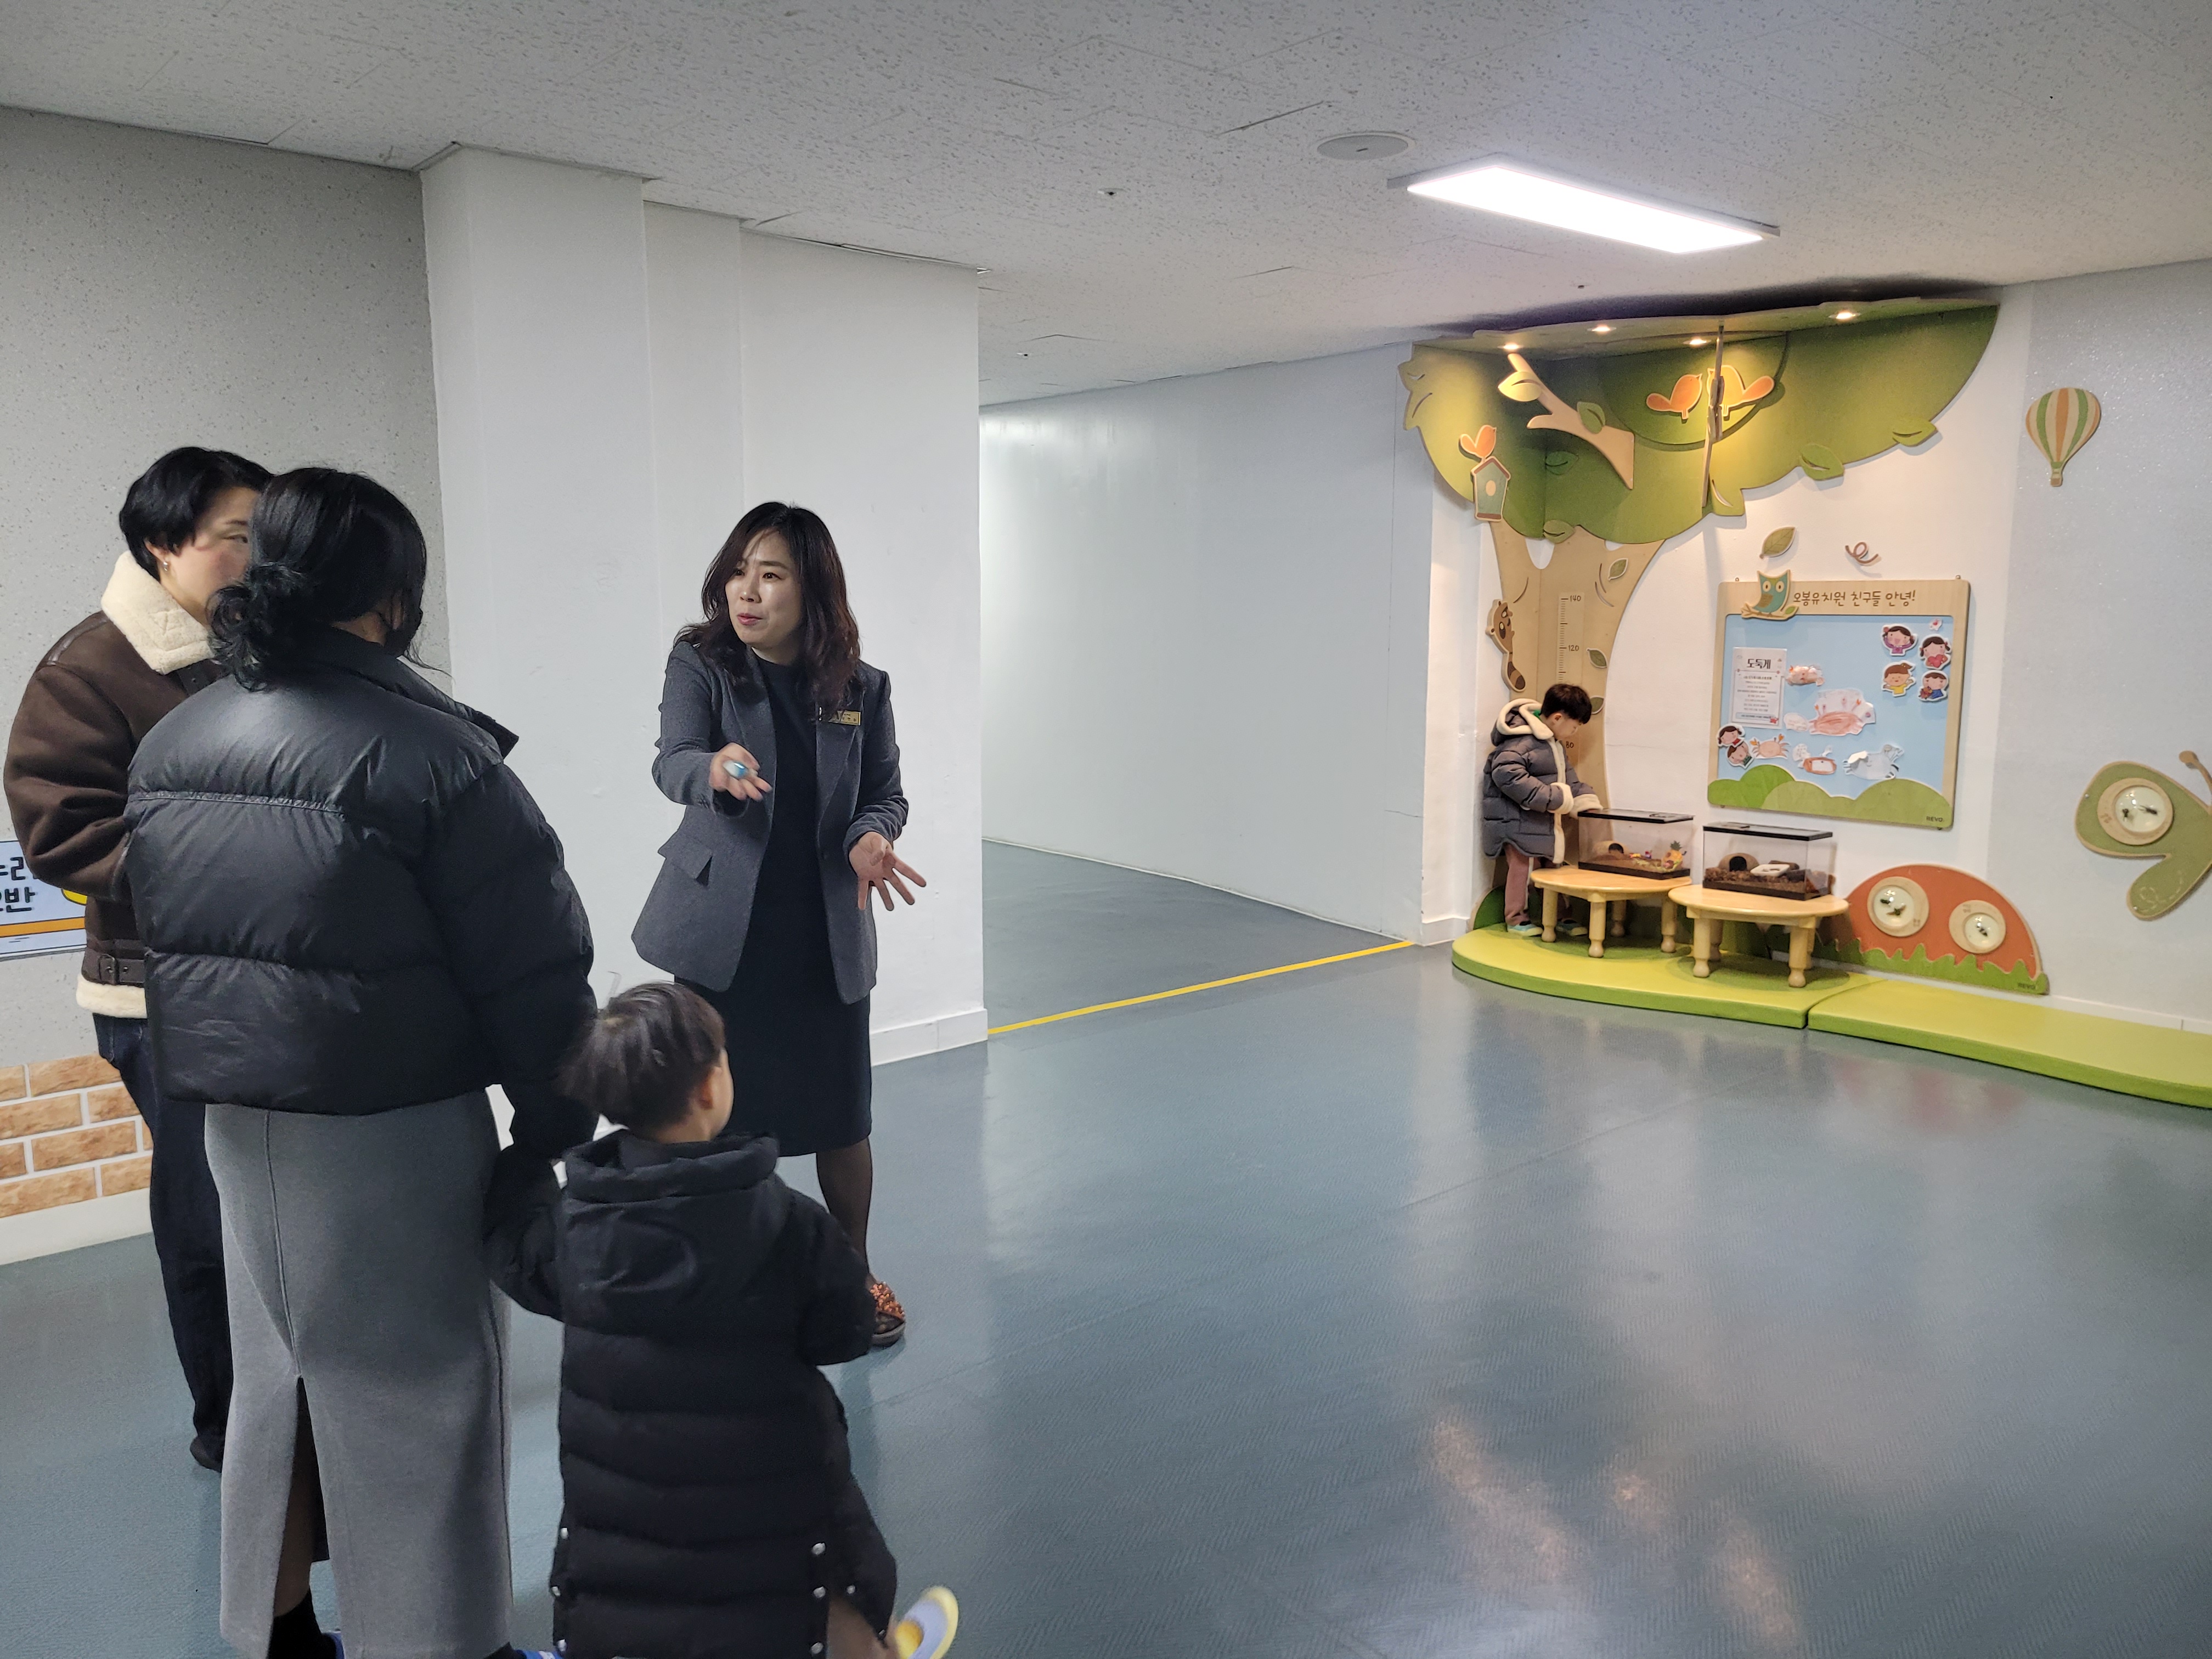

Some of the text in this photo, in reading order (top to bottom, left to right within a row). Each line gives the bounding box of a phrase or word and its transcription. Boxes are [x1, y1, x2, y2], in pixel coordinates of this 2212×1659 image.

[1793, 590, 1916, 607] 오봉유치원 친구들 안녕!
[1747, 658, 1771, 669] 도둑게
